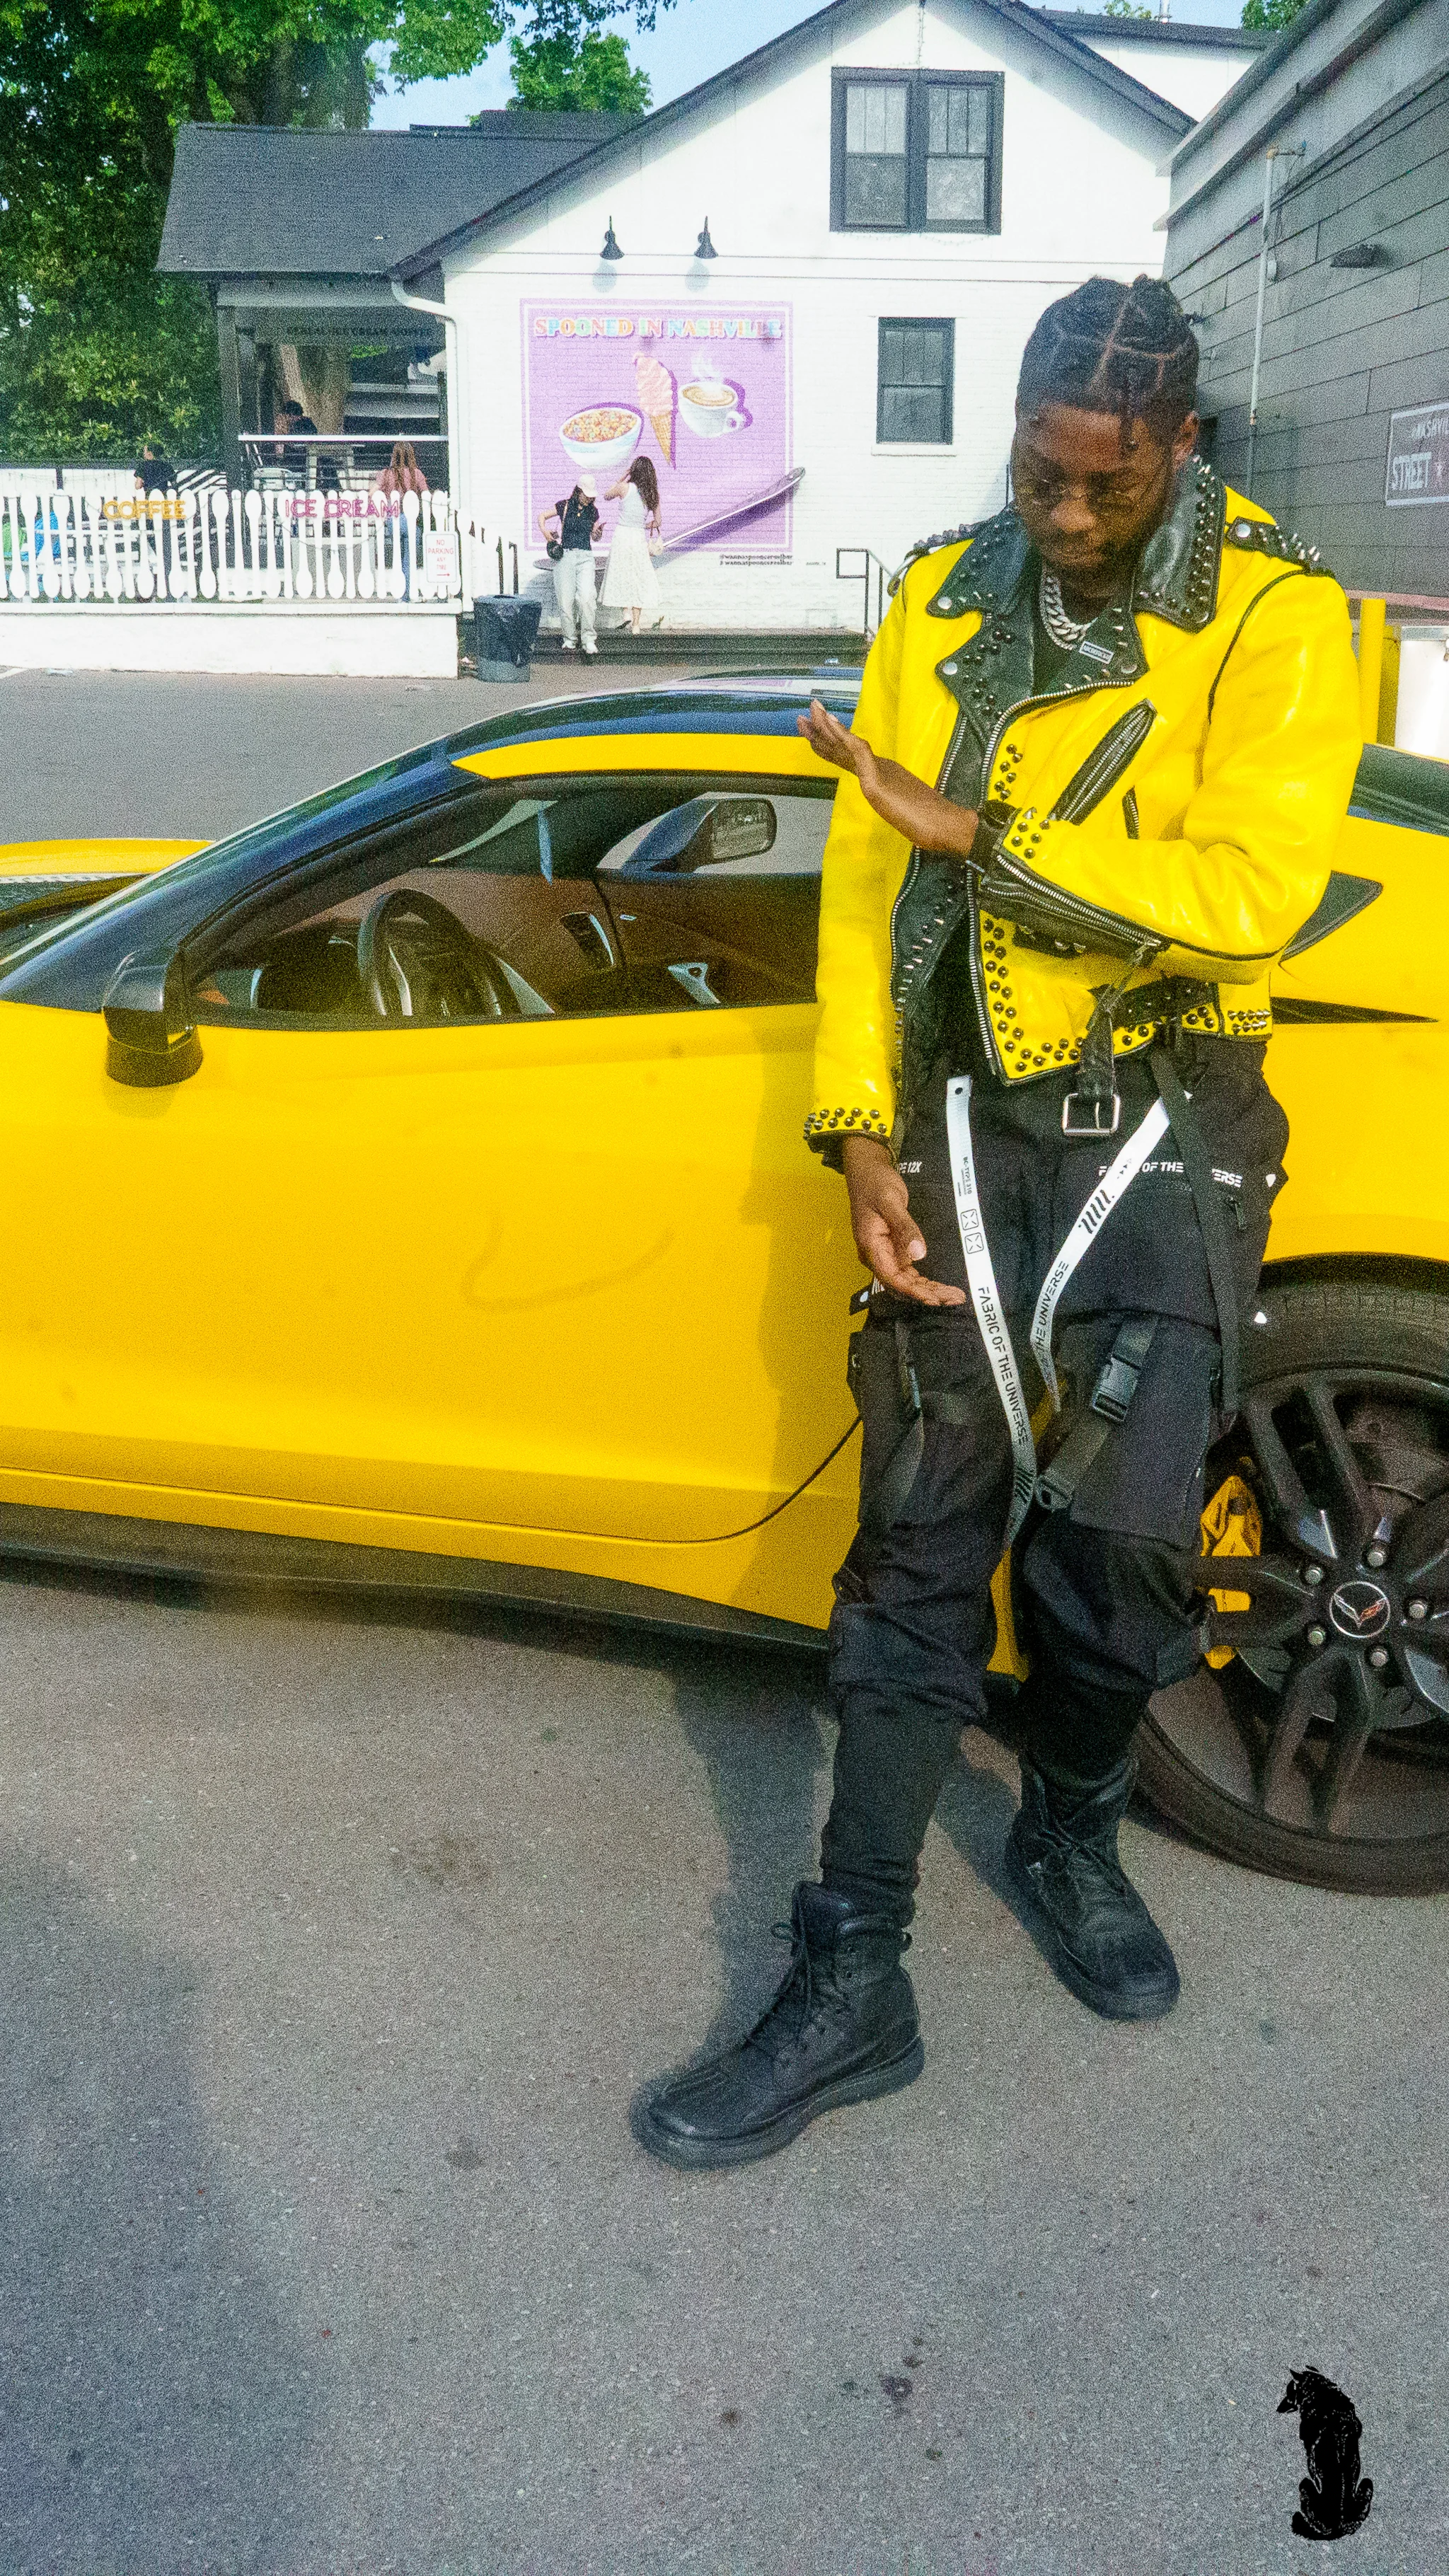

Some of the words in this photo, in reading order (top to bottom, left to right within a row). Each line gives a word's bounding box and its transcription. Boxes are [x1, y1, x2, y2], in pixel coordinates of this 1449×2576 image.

[534, 318, 634, 337] SPOONED
[639, 318, 662, 337] IN
[668, 318, 782, 338] NASHVILLE
[1392, 451, 1432, 490] STREET
[103, 499, 187, 520] COFFEE
[285, 499, 317, 518] ICE
[324, 499, 400, 518] CREAM
[1142, 1162, 1159, 1173] OF
[1160, 1161, 1184, 1173] THE
[1039, 1261, 1069, 1327] UNIVERSE
[978, 1286, 1000, 1334] FABRIC
[992, 1336, 1006, 1353] OF
[998, 1354, 1013, 1382] THE
[1005, 1382, 1029, 1445] UNIVERSE
